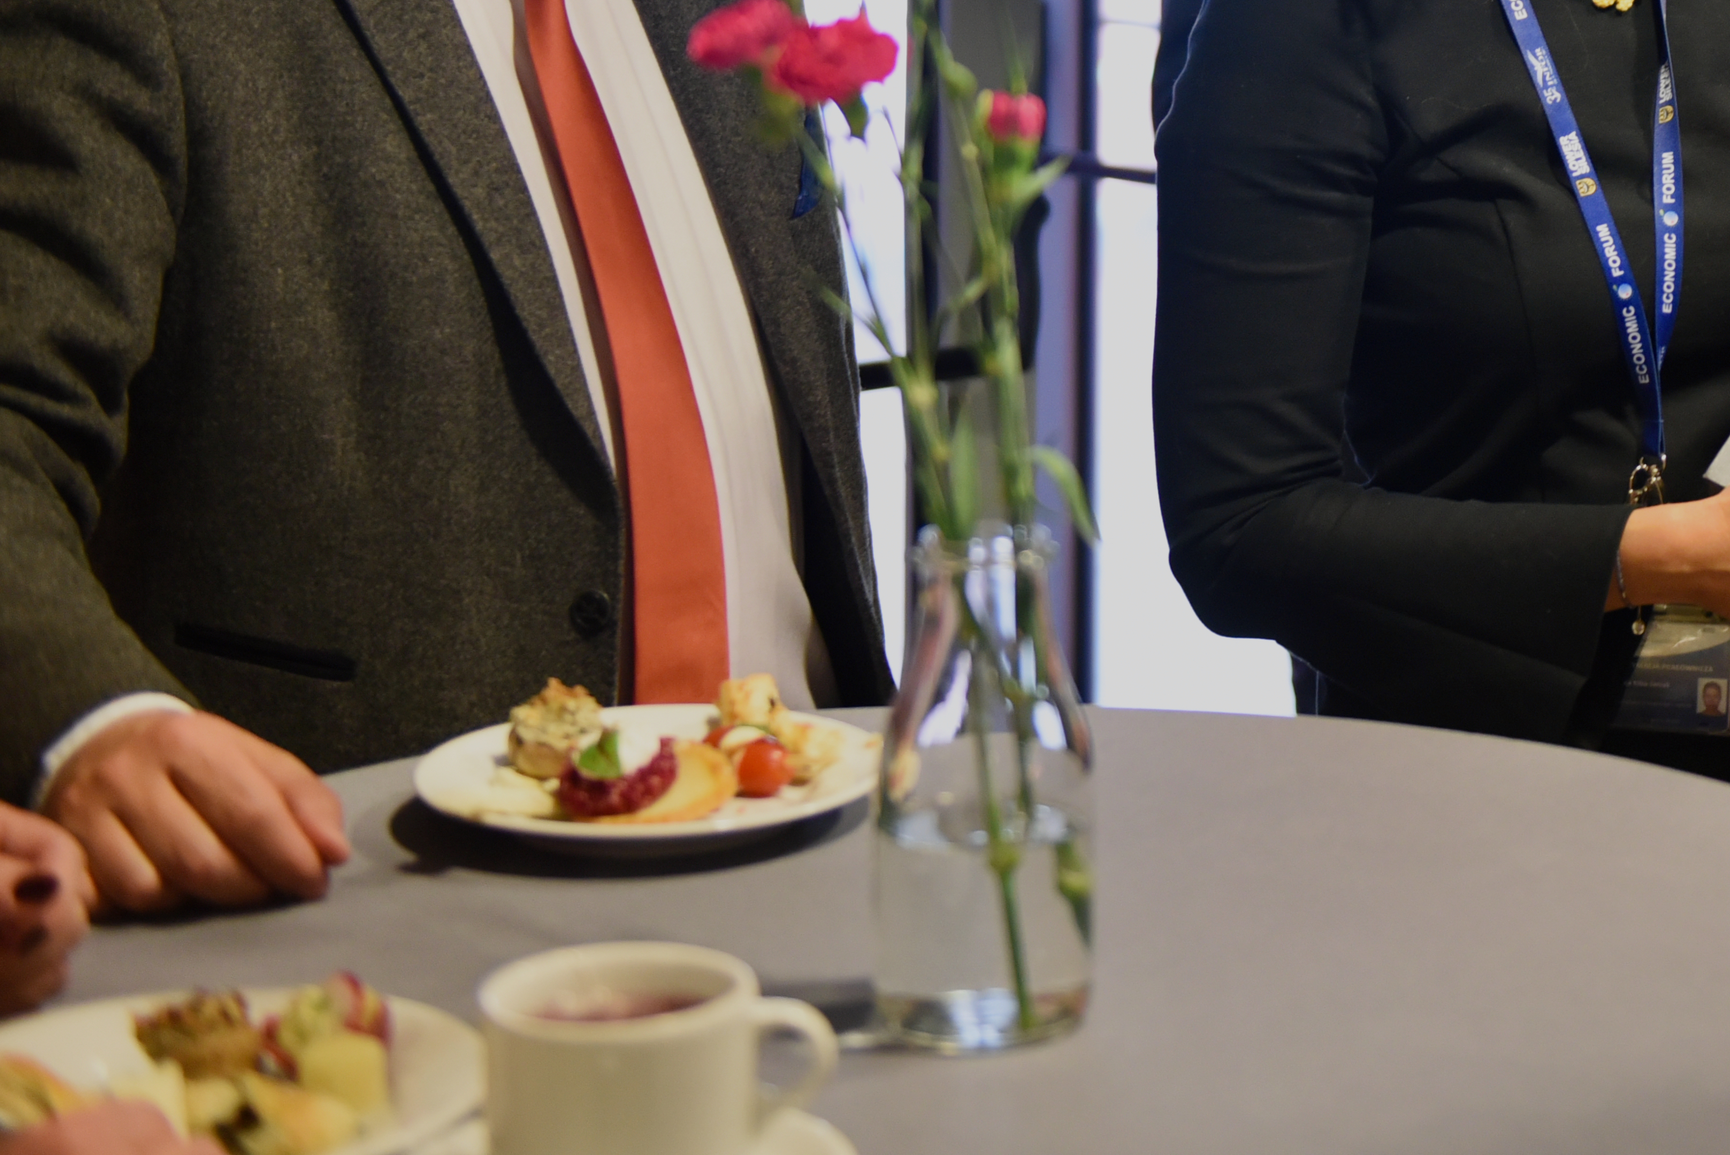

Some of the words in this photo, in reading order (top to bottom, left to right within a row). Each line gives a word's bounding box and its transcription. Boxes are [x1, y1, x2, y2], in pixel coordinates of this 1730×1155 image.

[1543, 86, 1562, 105] 35
[1559, 135, 1580, 177] LOWER
[1568, 131, 1591, 175] SILESIA
[1661, 151, 1676, 204] FORUM
[1595, 223, 1624, 278] FORUM
[1661, 232, 1677, 314] ECONOMIC
[1622, 305, 1650, 384] ECONOMIC
